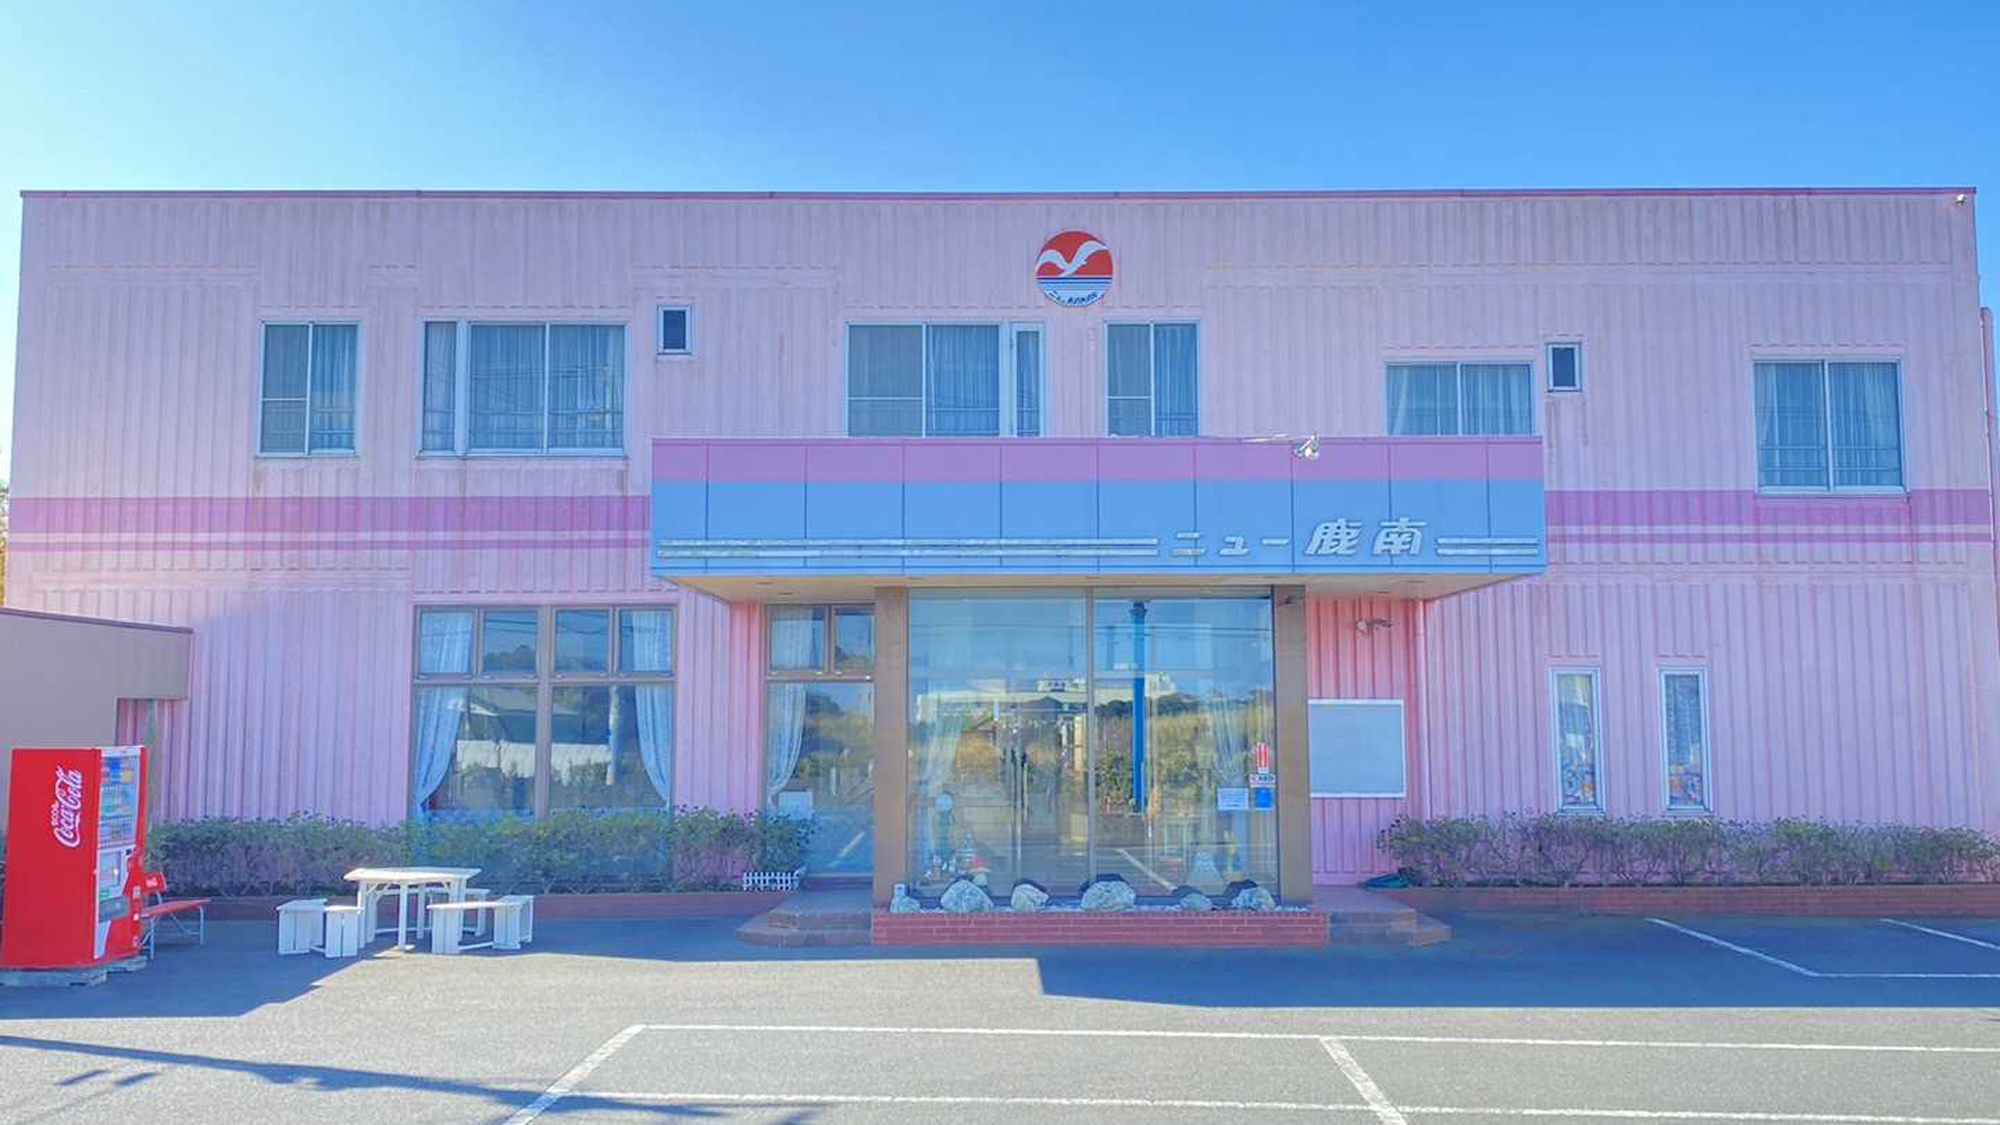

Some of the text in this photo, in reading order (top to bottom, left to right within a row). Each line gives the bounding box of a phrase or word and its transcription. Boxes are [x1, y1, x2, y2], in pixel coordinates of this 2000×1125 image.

[1172, 517, 1427, 557] ニュー鹿南
